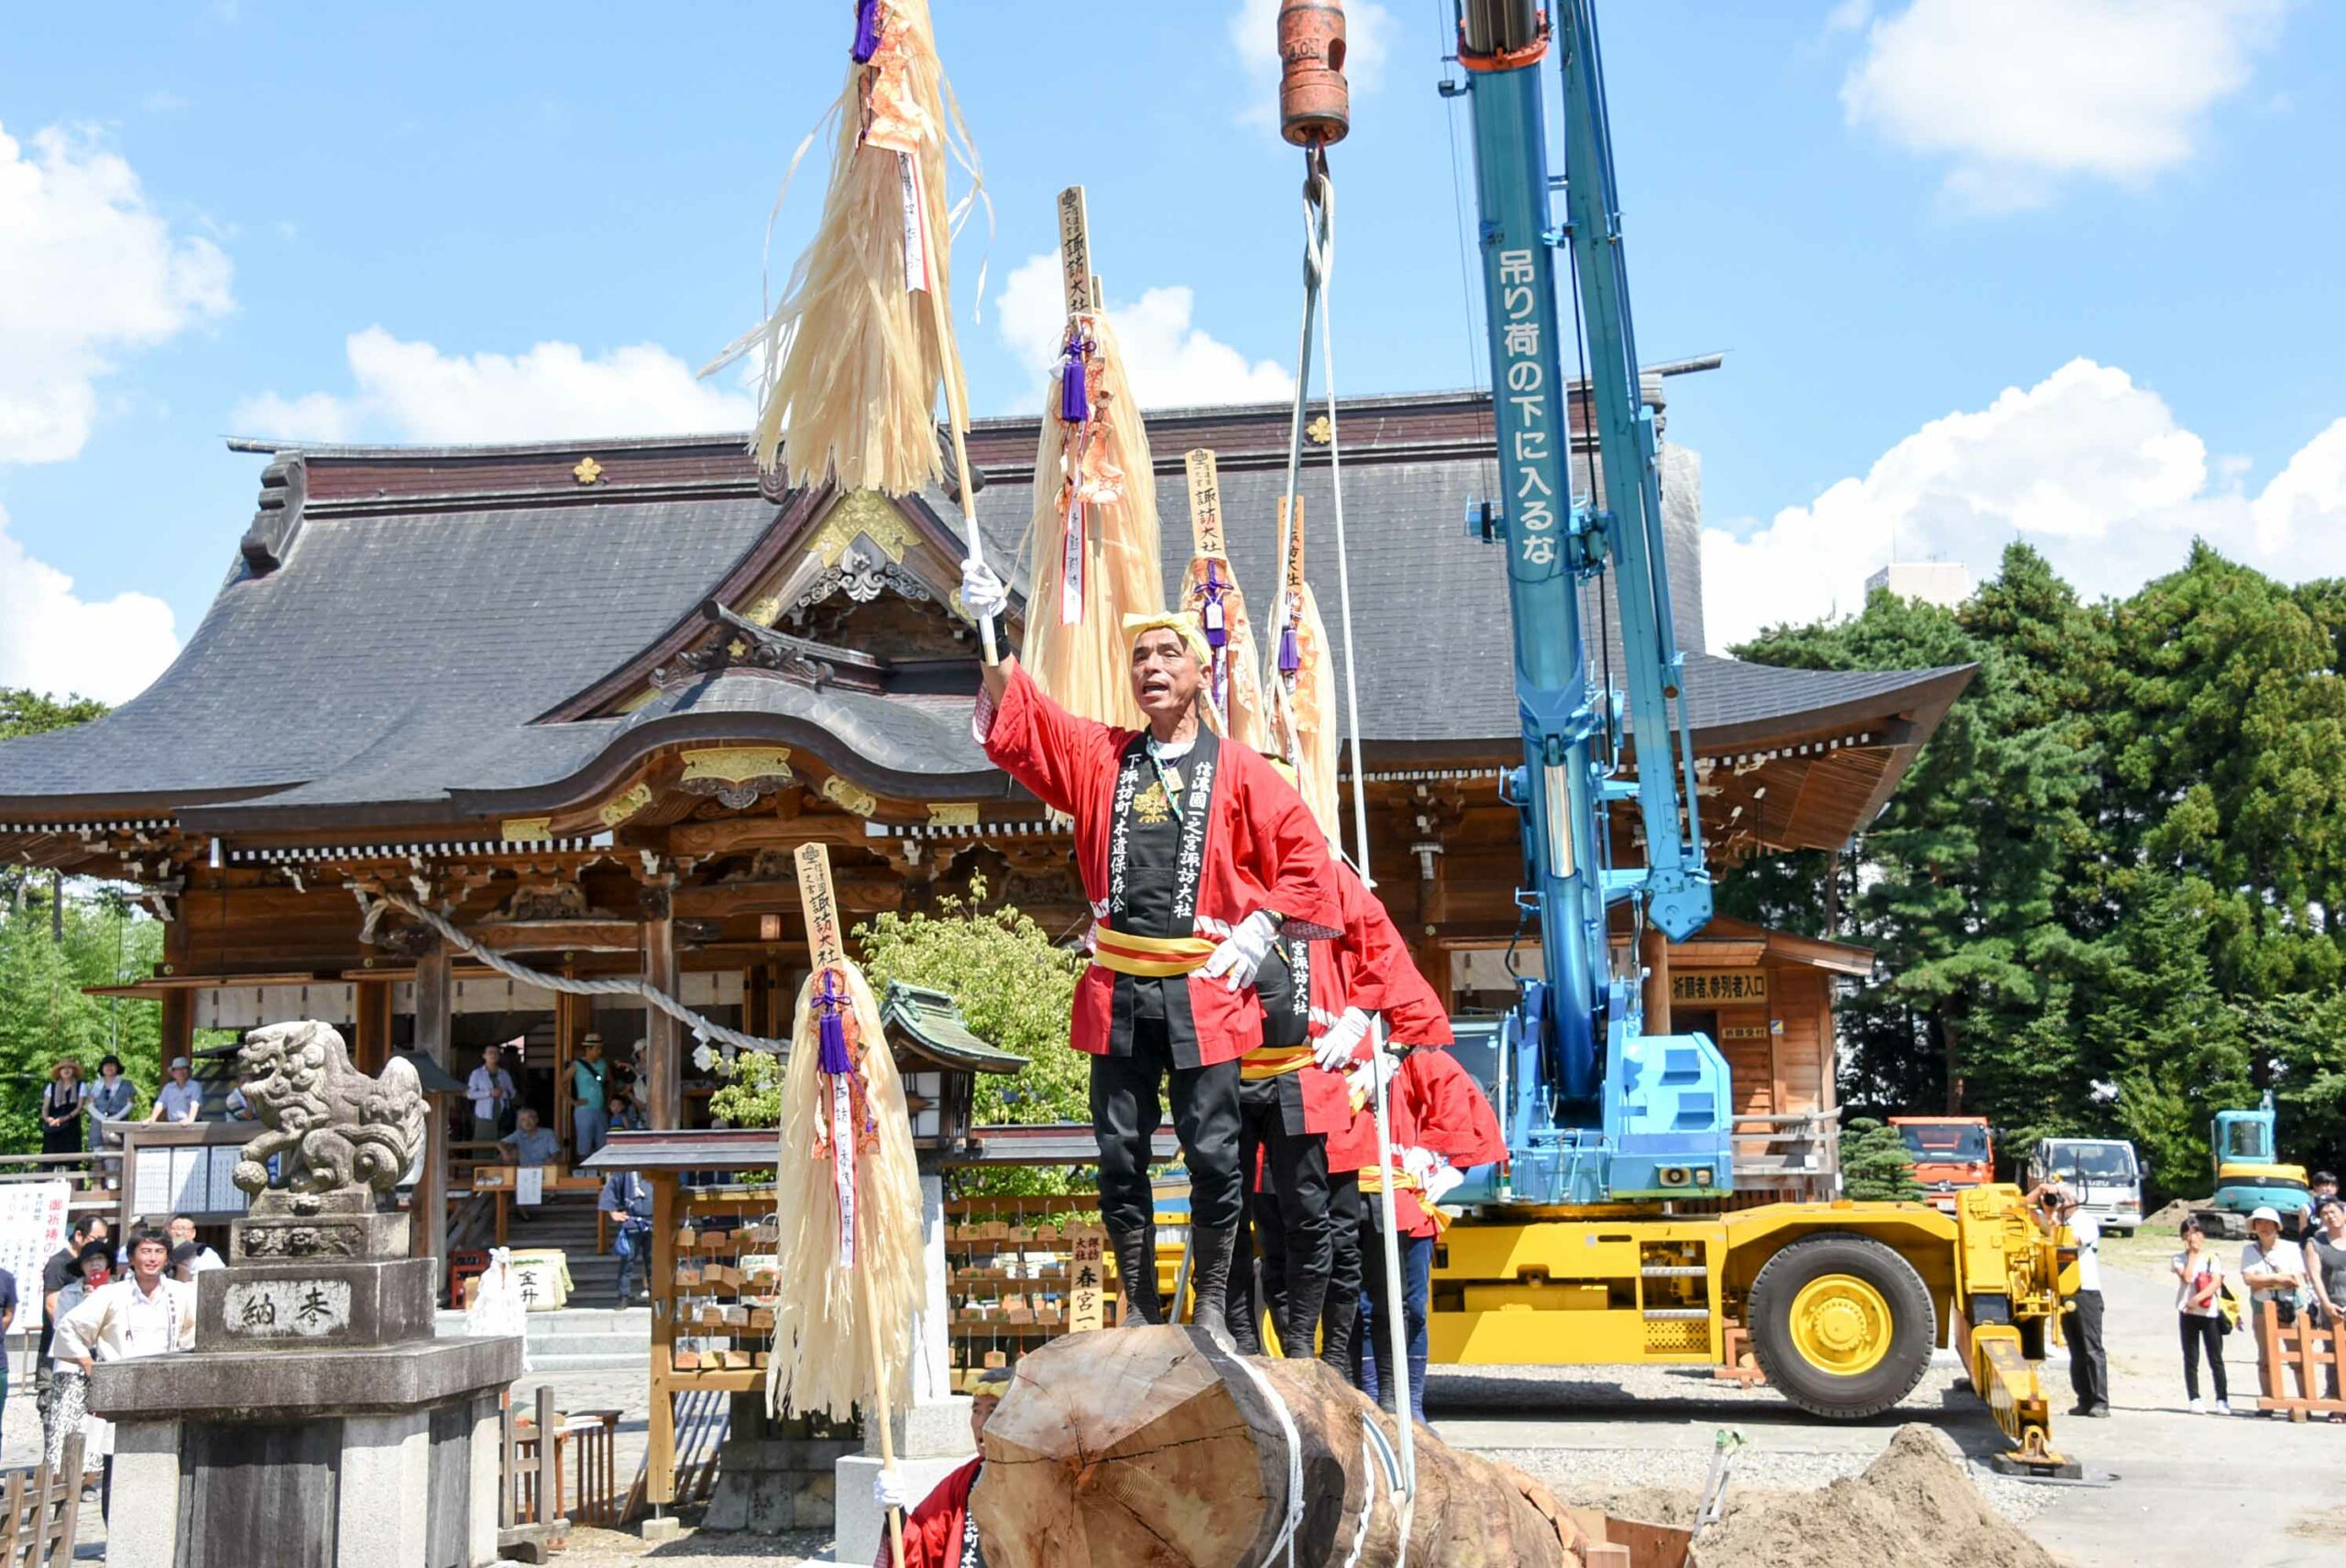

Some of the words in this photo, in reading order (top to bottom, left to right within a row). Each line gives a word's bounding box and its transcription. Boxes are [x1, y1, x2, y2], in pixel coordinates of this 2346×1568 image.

[1499, 249, 1555, 565] 吊り荷の下に入るな
[1197, 488, 1222, 553] 諏訪大社
[1110, 752, 1143, 913] 下諏訪町木遣保存会
[1173, 761, 1214, 919] 信濃國一之宮諏訪大社
[808, 891, 840, 967] 諏訪大社
[1075, 1265, 1098, 1328] 春宮一
